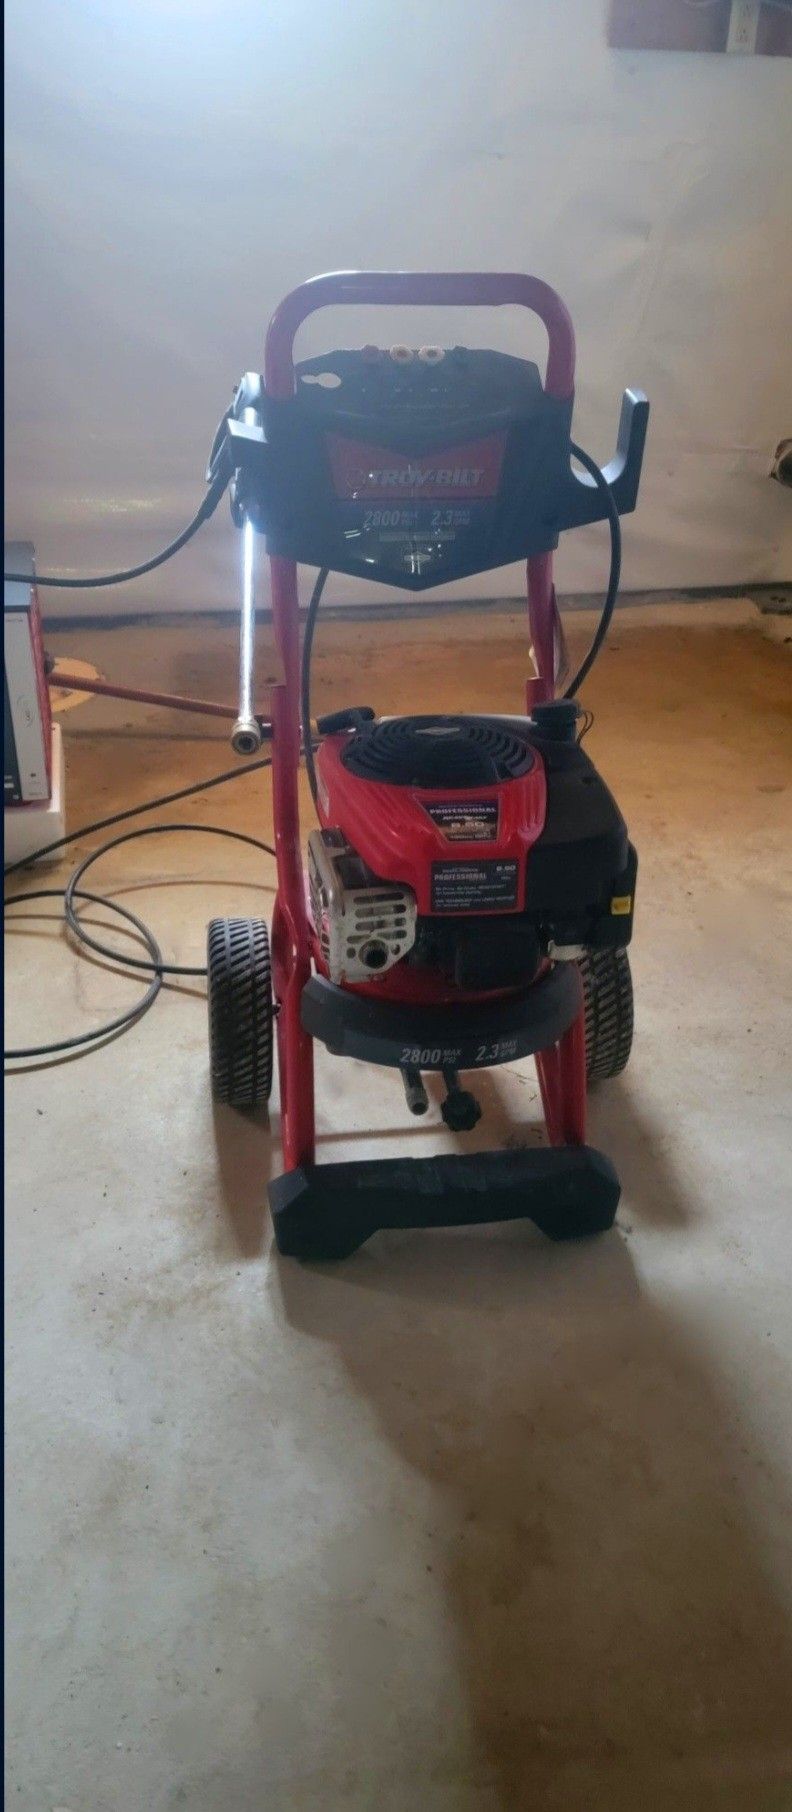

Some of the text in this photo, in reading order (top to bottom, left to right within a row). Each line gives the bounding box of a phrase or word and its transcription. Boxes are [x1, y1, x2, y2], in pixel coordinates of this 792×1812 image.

[368, 468, 485, 487] TROY-BILT
[363, 510, 452, 526] 2800 2.3
[400, 1044, 499, 1064] 2800 2.3
[442, 1040, 518, 1056] MAX MAX
